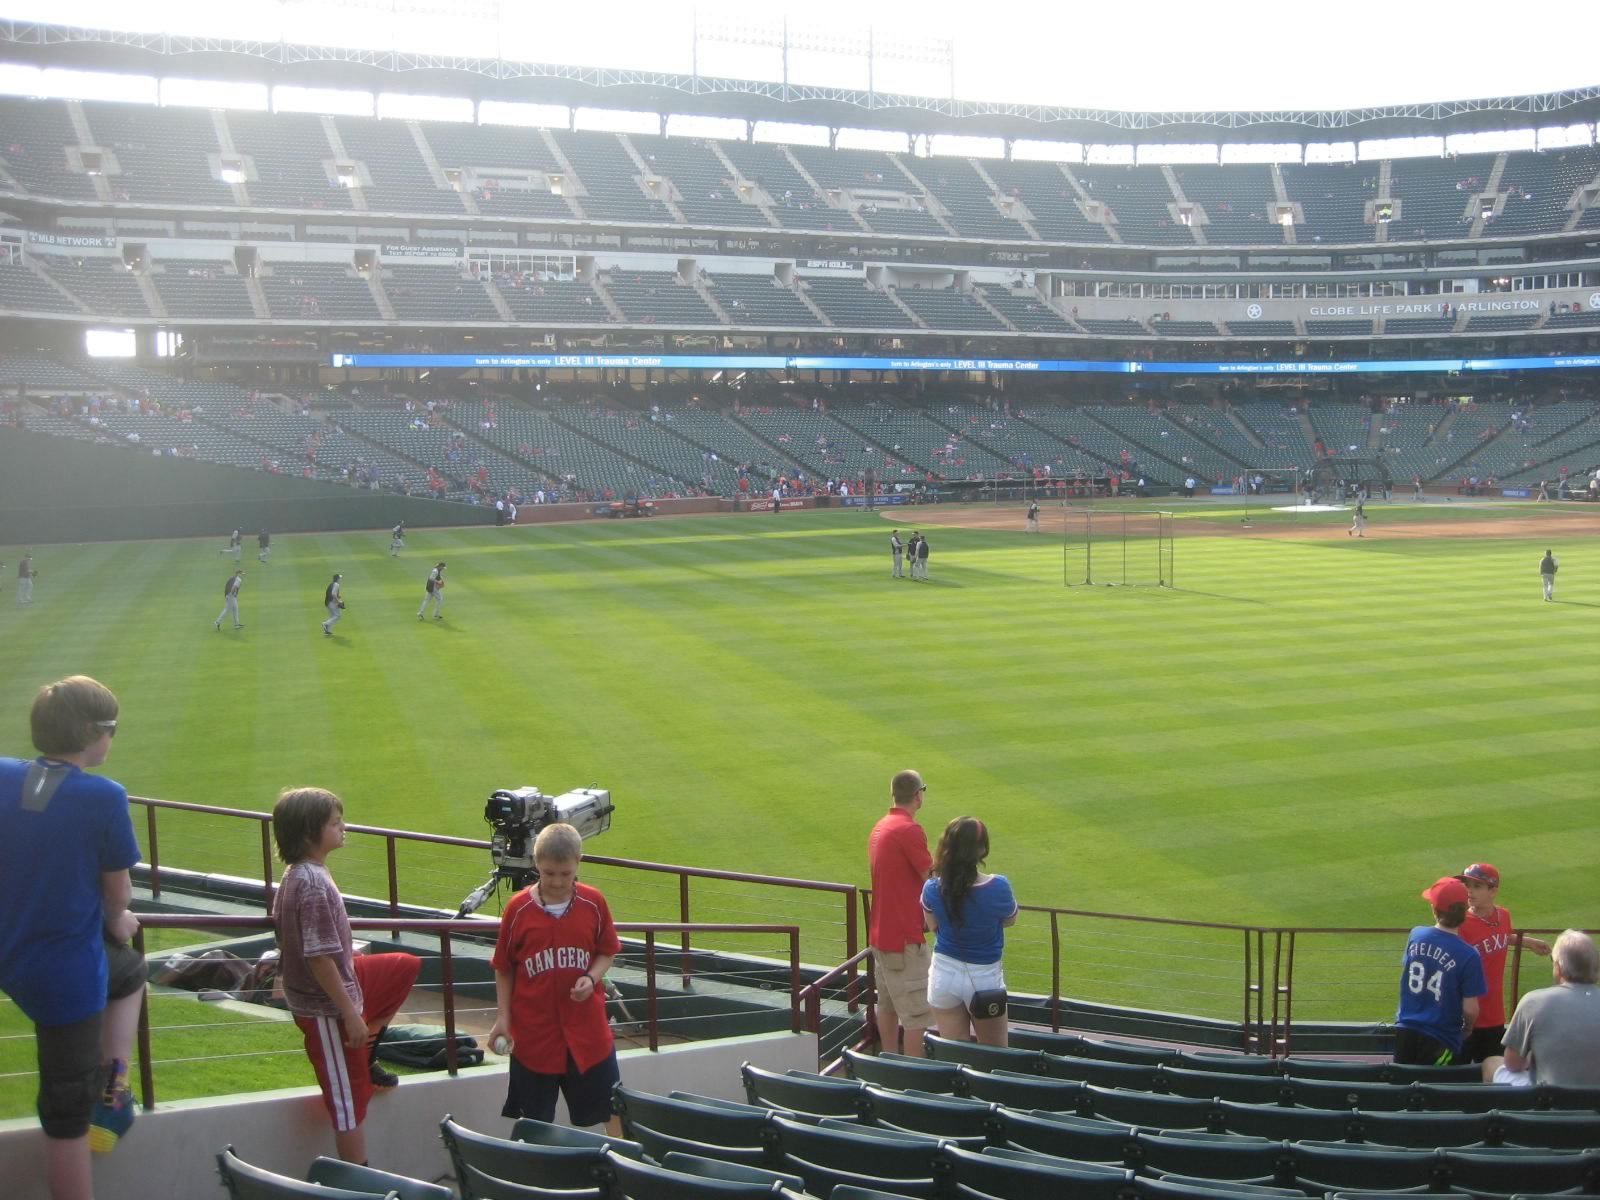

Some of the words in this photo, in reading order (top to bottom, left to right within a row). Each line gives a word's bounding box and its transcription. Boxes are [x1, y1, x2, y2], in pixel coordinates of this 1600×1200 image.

[38, 234, 55, 243] MLB
[57, 237, 102, 246] NETWORK
[1310, 306, 1354, 316] GLOBE
[1360, 305, 1391, 315] LIFE
[1396, 304, 1432, 314] PARK
[1458, 300, 1539, 311] ARLINGTON
[554, 356, 582, 366] LEVEL
[597, 356, 629, 366] Trauma
[631, 357, 662, 366] Center
[953, 360, 976, 369] LEVEL
[987, 361, 1013, 369] Trauma
[1015, 361, 1040, 370] Center
[1276, 364, 1297, 372] LEVEL
[1308, 363, 1332, 371] Trauma
[1334, 363, 1358, 371] Center
[524, 946, 591, 978] RANGERS
[1409, 942, 1456, 972] FIELDER
[1408, 960, 1443, 1002] 84
